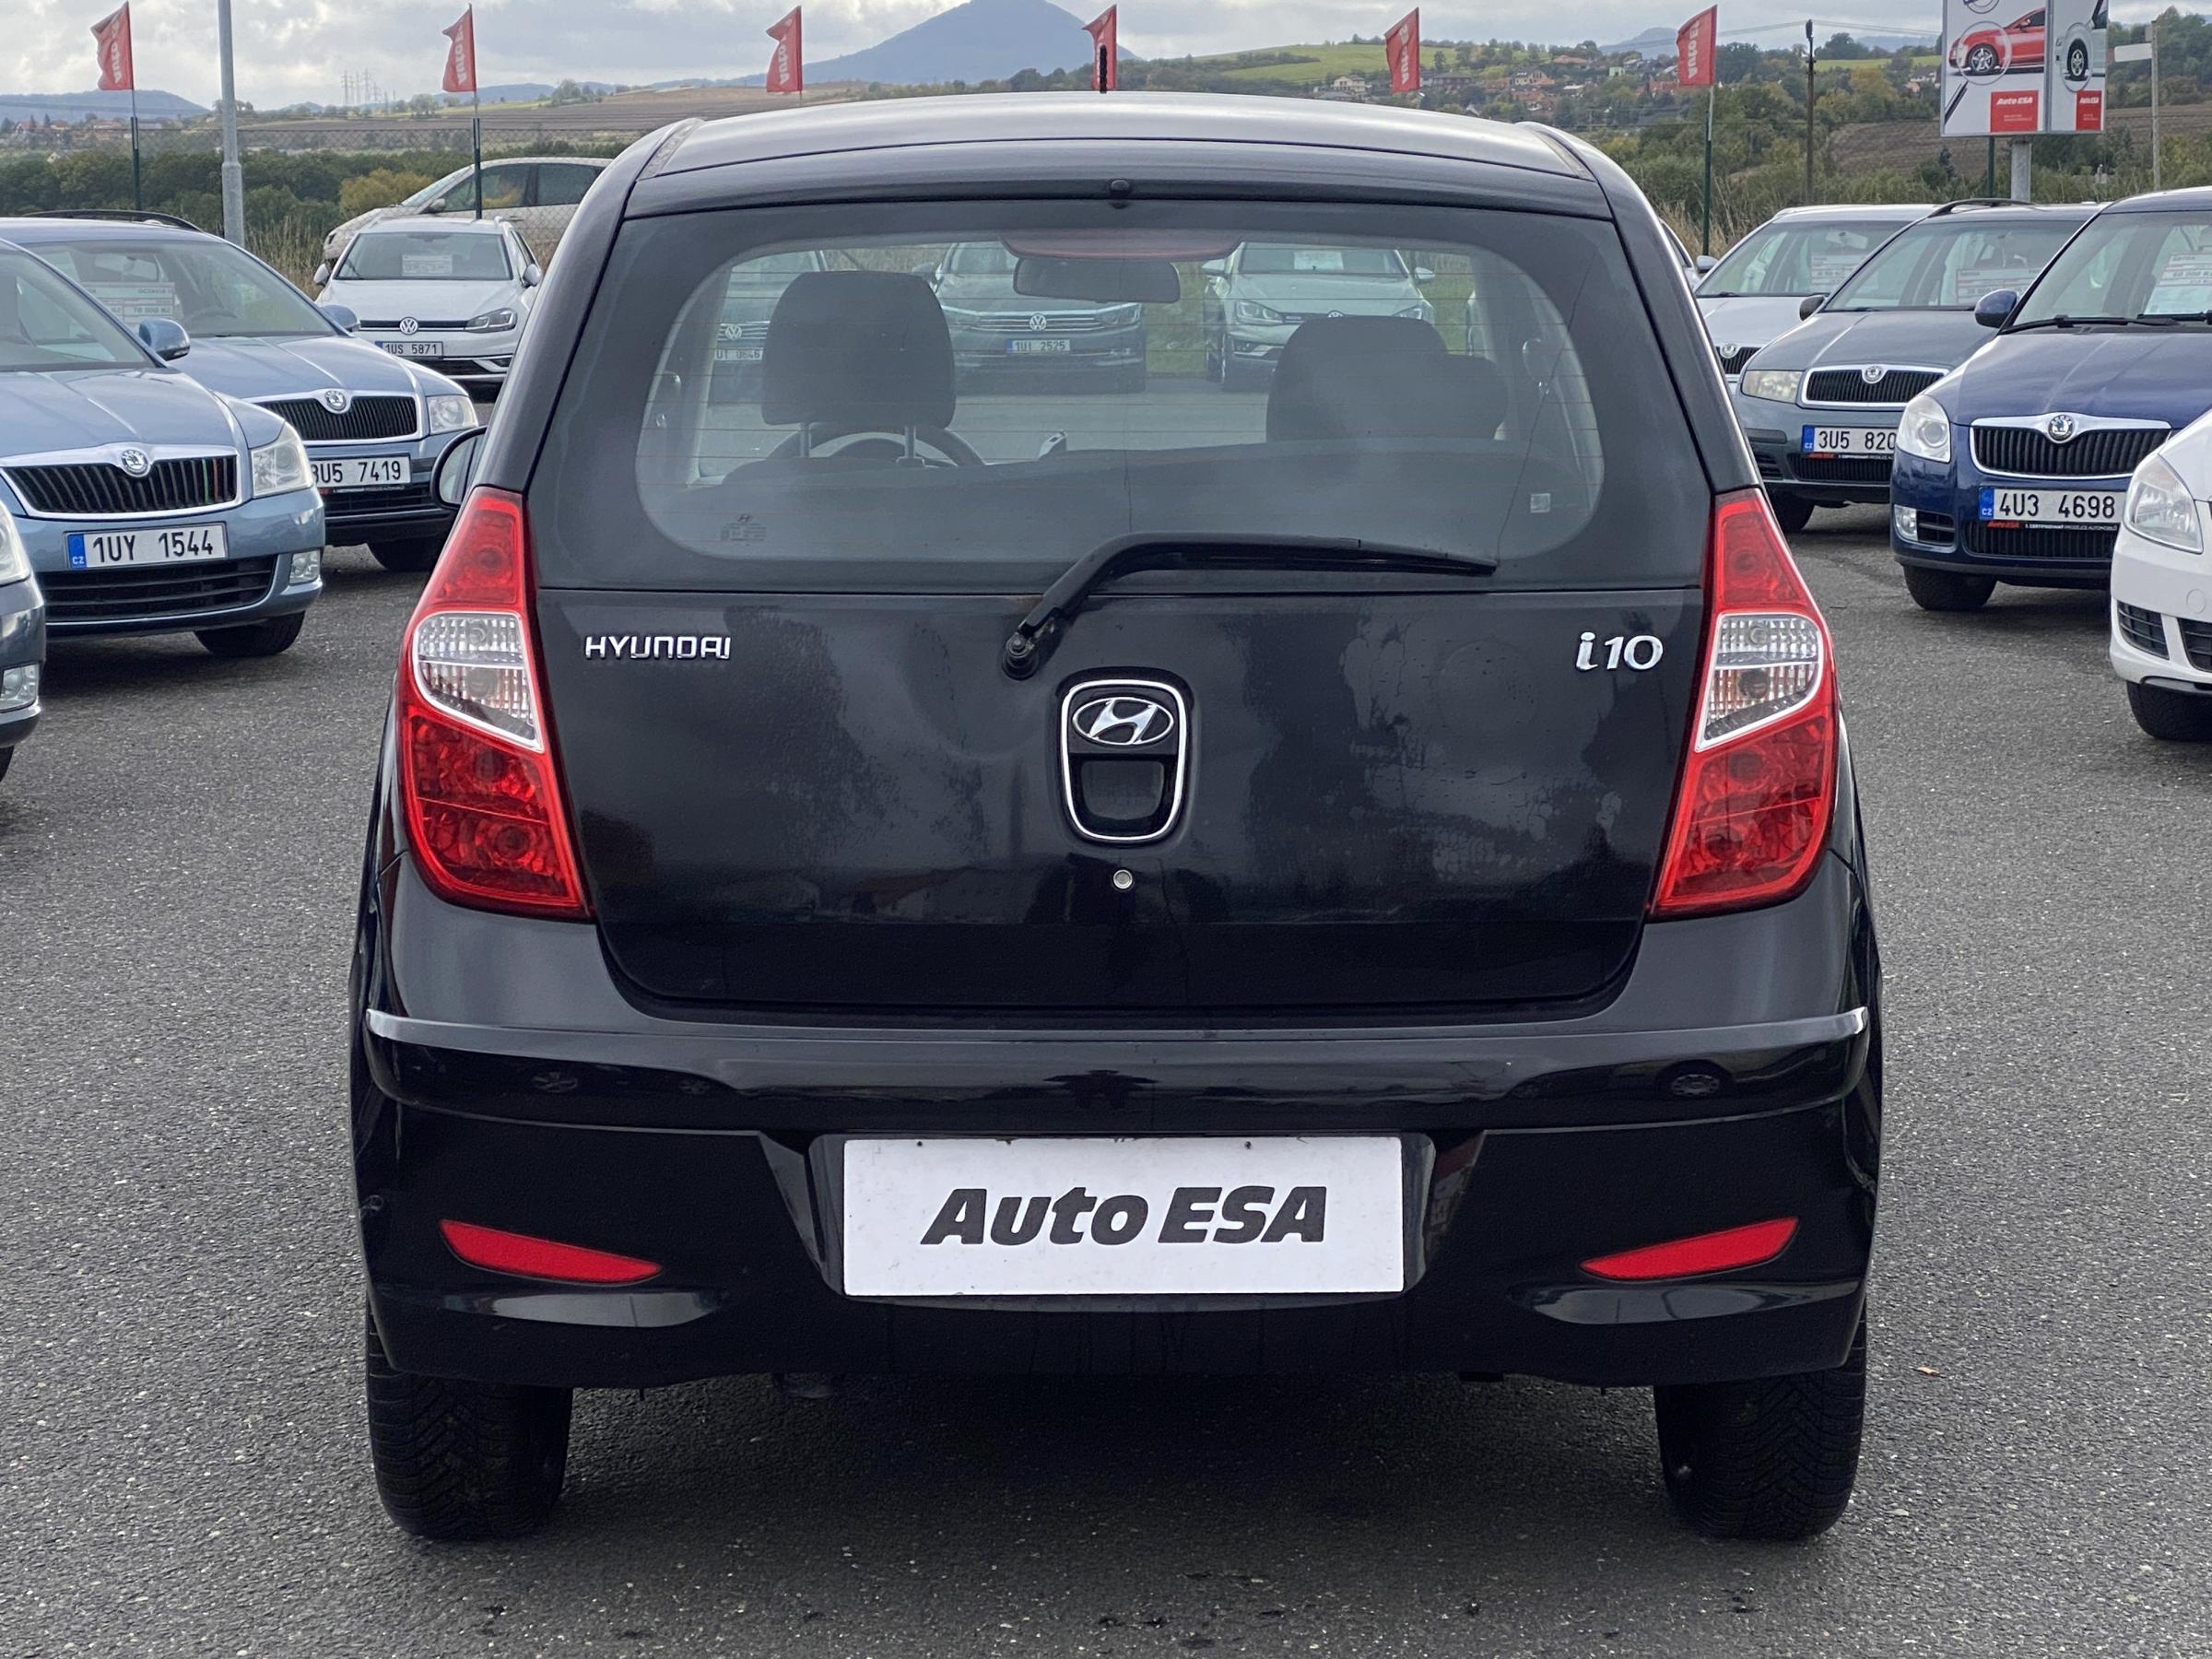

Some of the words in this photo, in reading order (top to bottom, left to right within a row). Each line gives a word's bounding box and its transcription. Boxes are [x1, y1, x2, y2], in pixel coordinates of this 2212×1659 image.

[385, 344, 404, 355] 1US
[411, 344, 438, 355] 5871
[1818, 430, 1851, 450] 3U5
[358, 460, 401, 482] 7419
[1982, 508, 1993, 516] CZ
[1999, 492, 2040, 517] 4U3
[2058, 494, 2115, 519] 4698
[92, 535, 135, 563] 1UY
[158, 529, 213, 559] 1544
[72, 556, 85, 565] CZ
[585, 636, 731, 660] HYUNDAI
[1576, 631, 1664, 671] i10
[920, 1186, 1149, 1246] Auto
[1157, 1185, 1327, 1243] ESA
